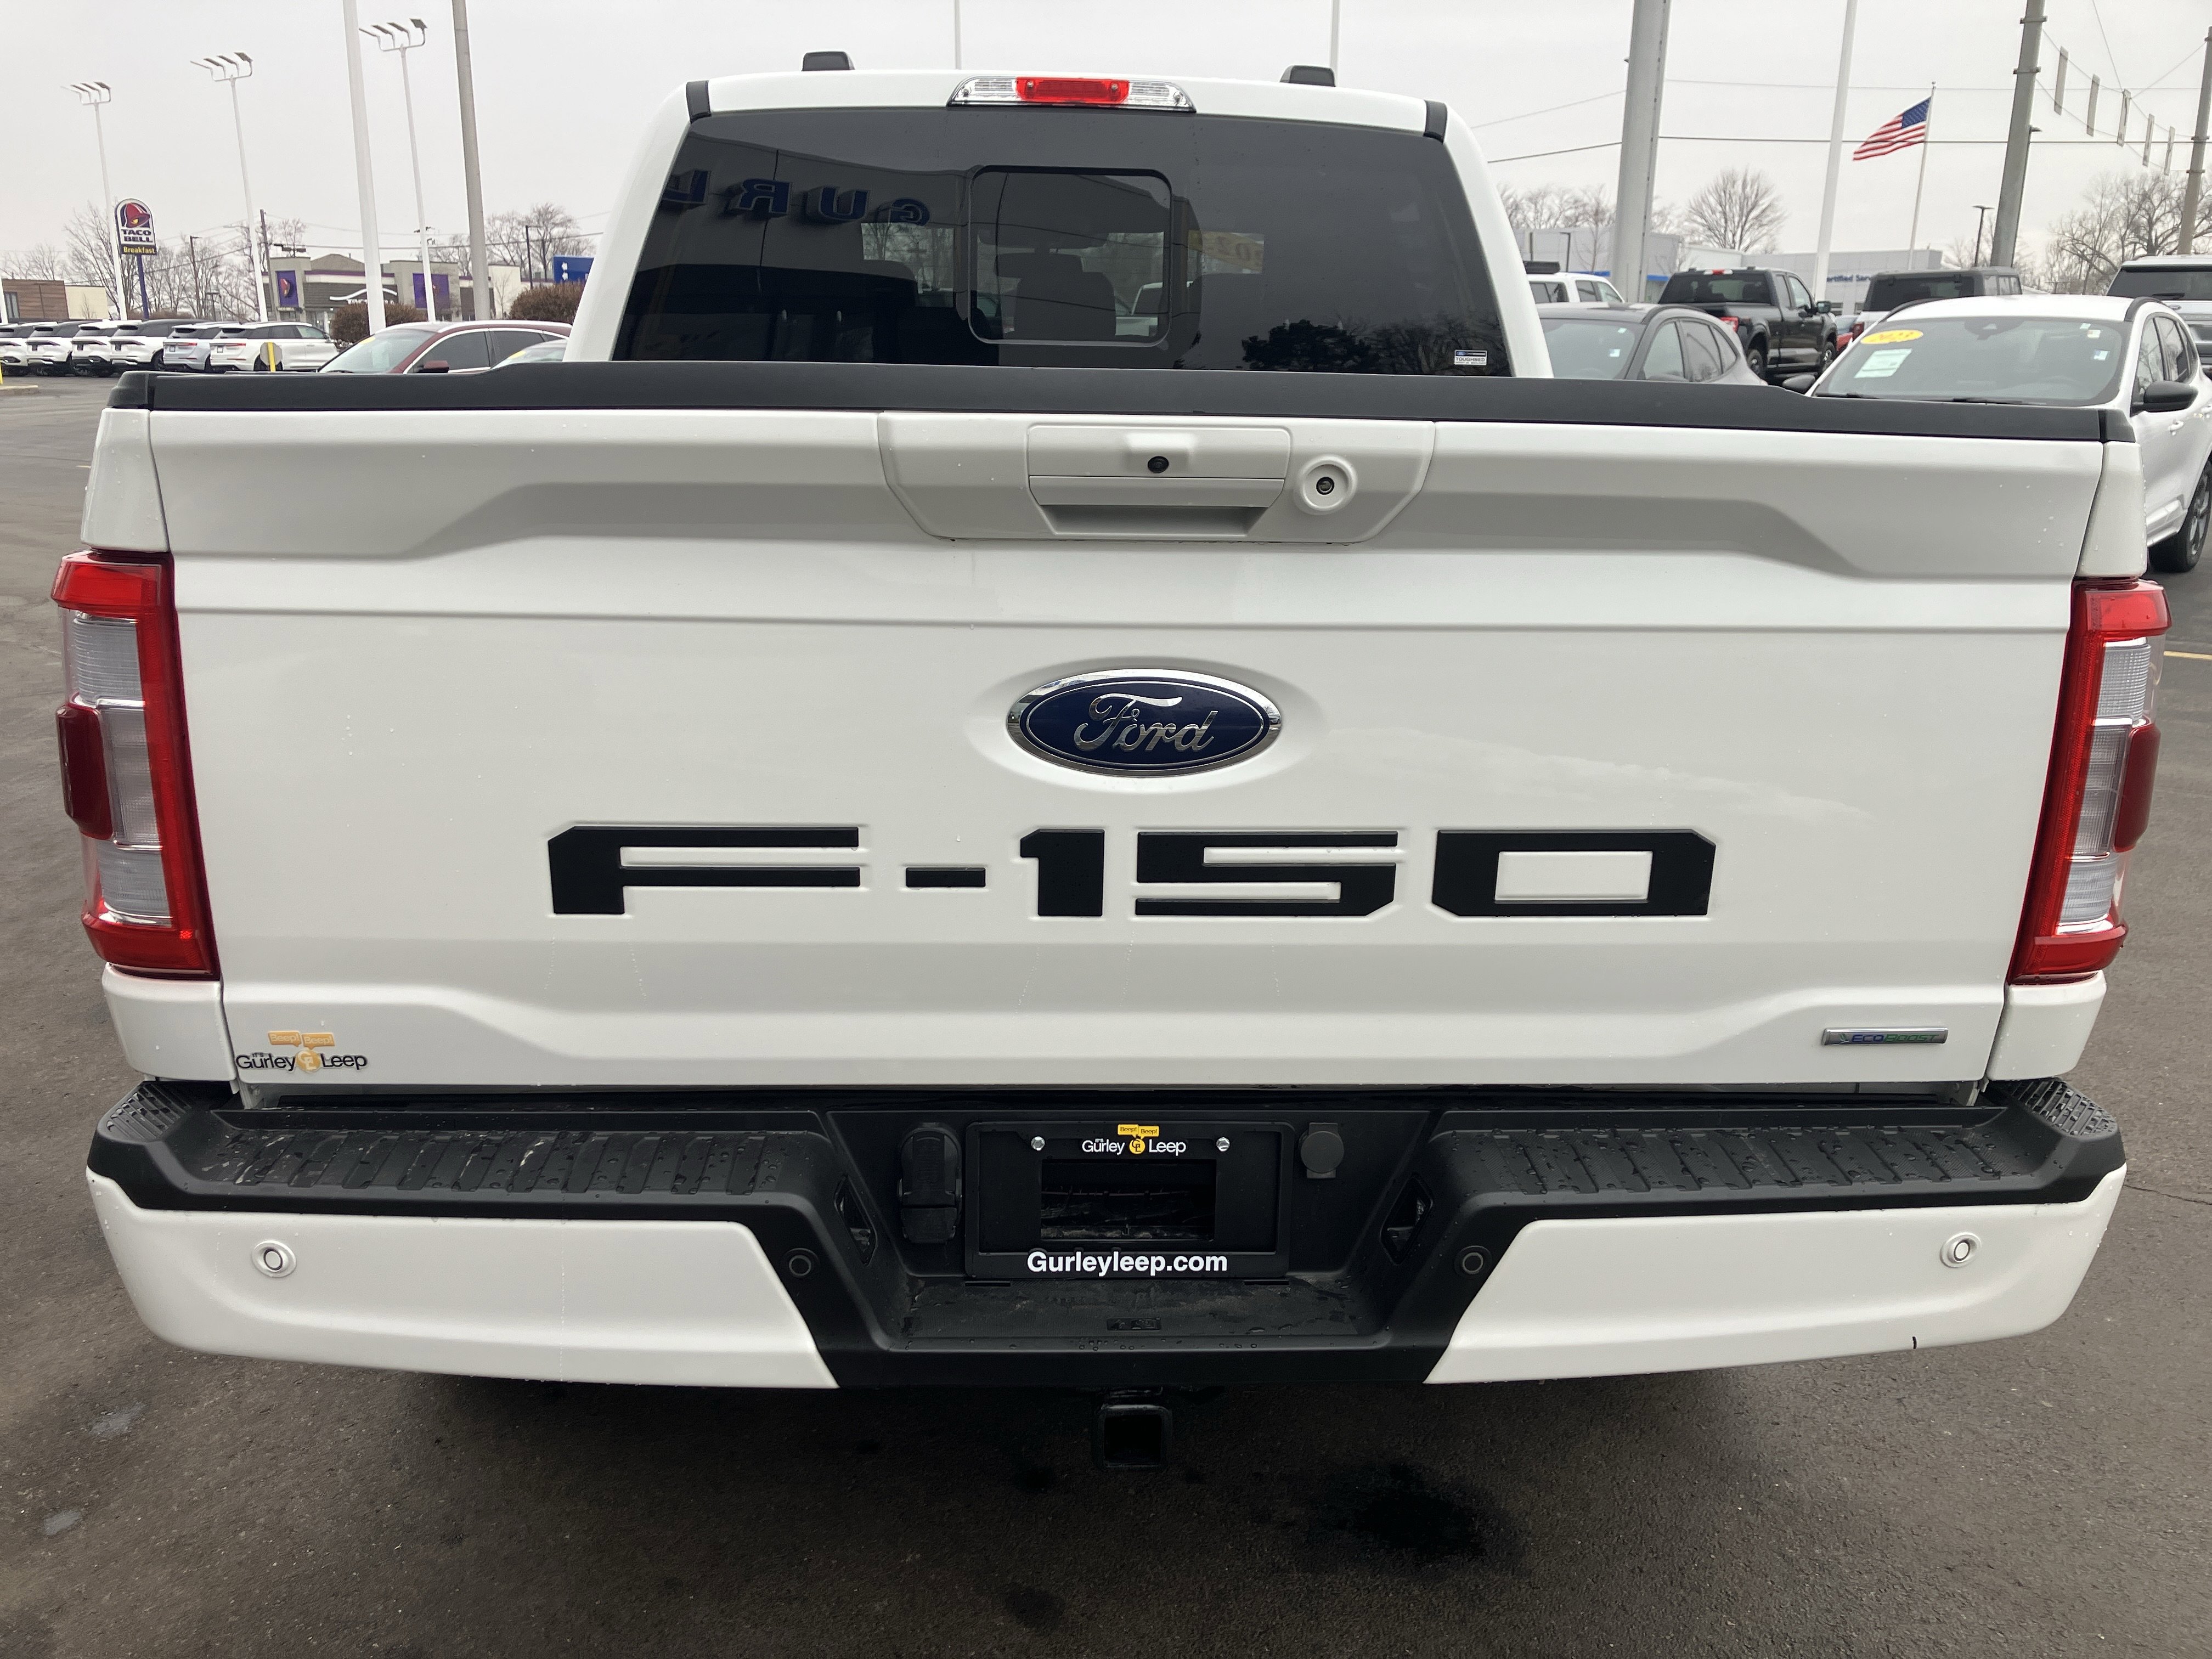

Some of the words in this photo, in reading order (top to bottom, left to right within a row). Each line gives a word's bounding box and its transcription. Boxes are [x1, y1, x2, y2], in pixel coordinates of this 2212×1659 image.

[1074, 693, 1218, 751] Ford
[548, 826, 1716, 917] F-150
[304, 1036, 332, 1045] Beep!
[236, 1053, 296, 1071] Gurley
[320, 1053, 368, 1070] Leep
[1082, 1139, 1125, 1155] Gurley
[1149, 1139, 1187, 1156] Leep
[1027, 1251, 1228, 1277] Gurleyleep.com
